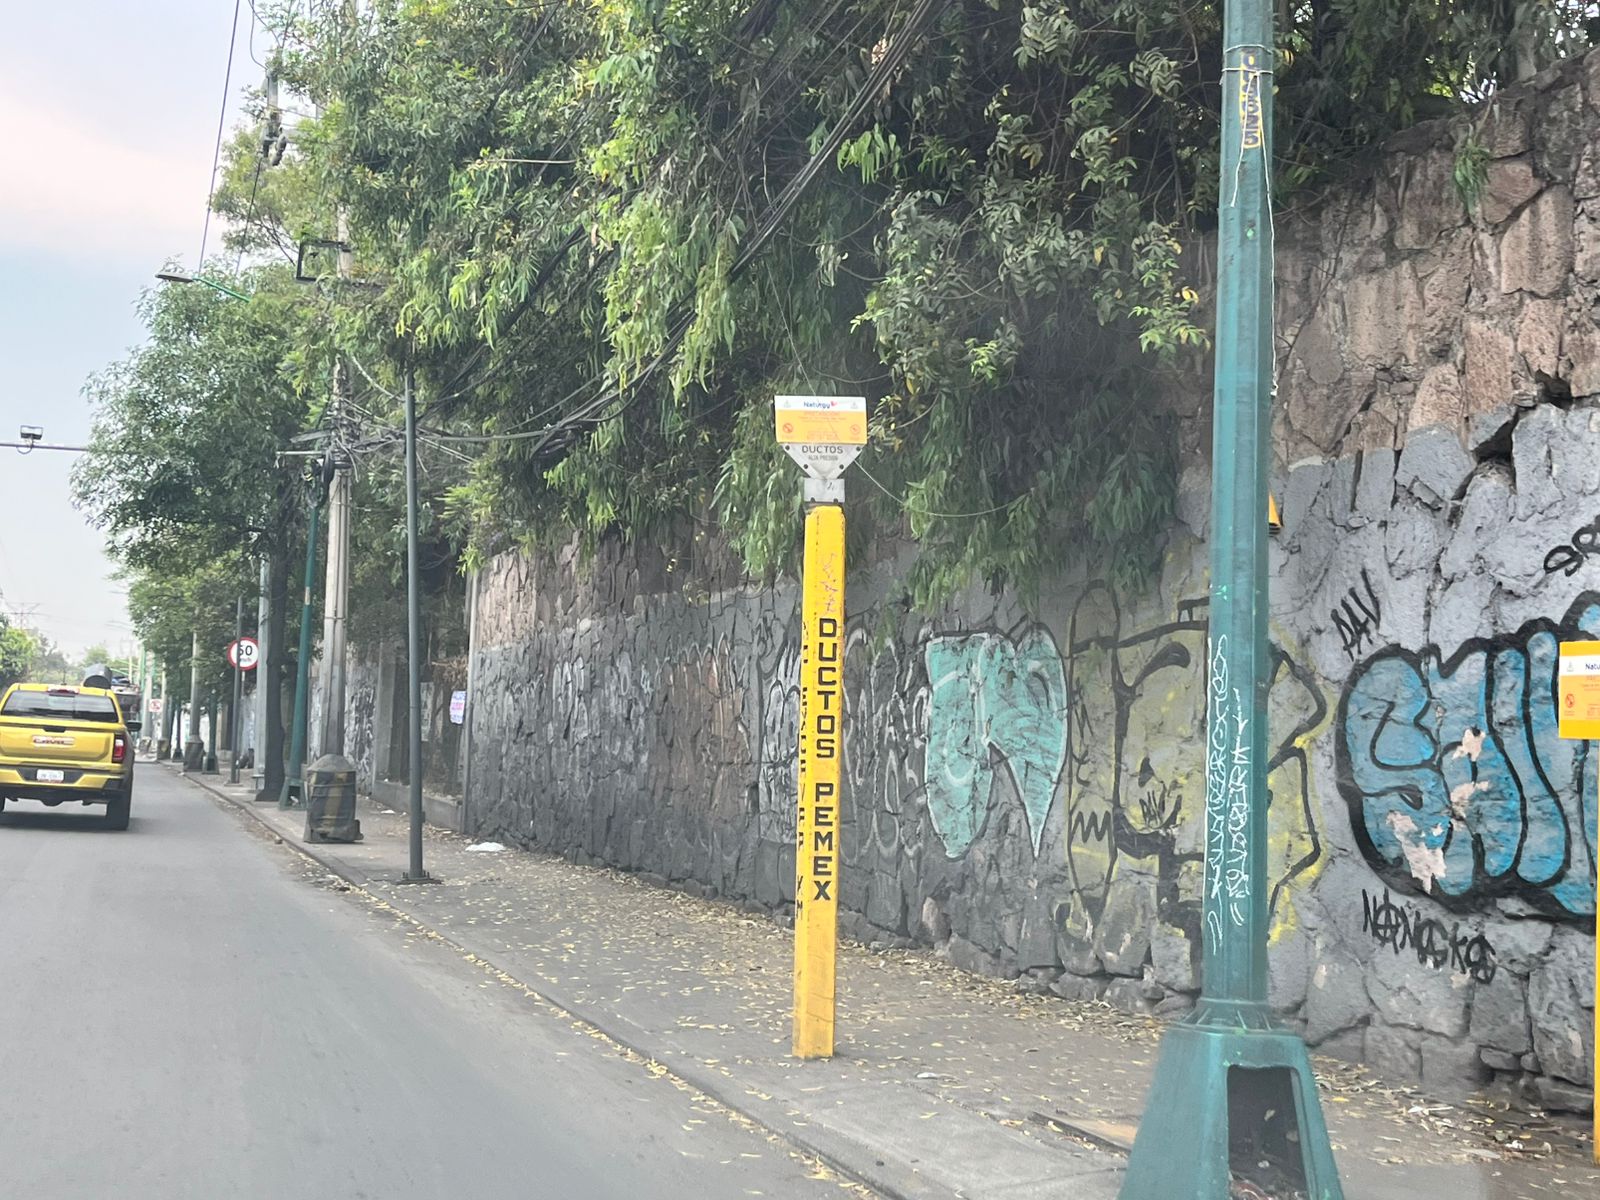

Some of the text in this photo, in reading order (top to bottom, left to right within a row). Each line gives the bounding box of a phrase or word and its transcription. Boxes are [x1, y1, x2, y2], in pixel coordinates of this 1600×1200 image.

[803, 401, 831, 409] Naturgy
[801, 445, 843, 454] DUCTOS
[815, 617, 838, 759] DUCTOS
[812, 782, 835, 901] PEMEX
